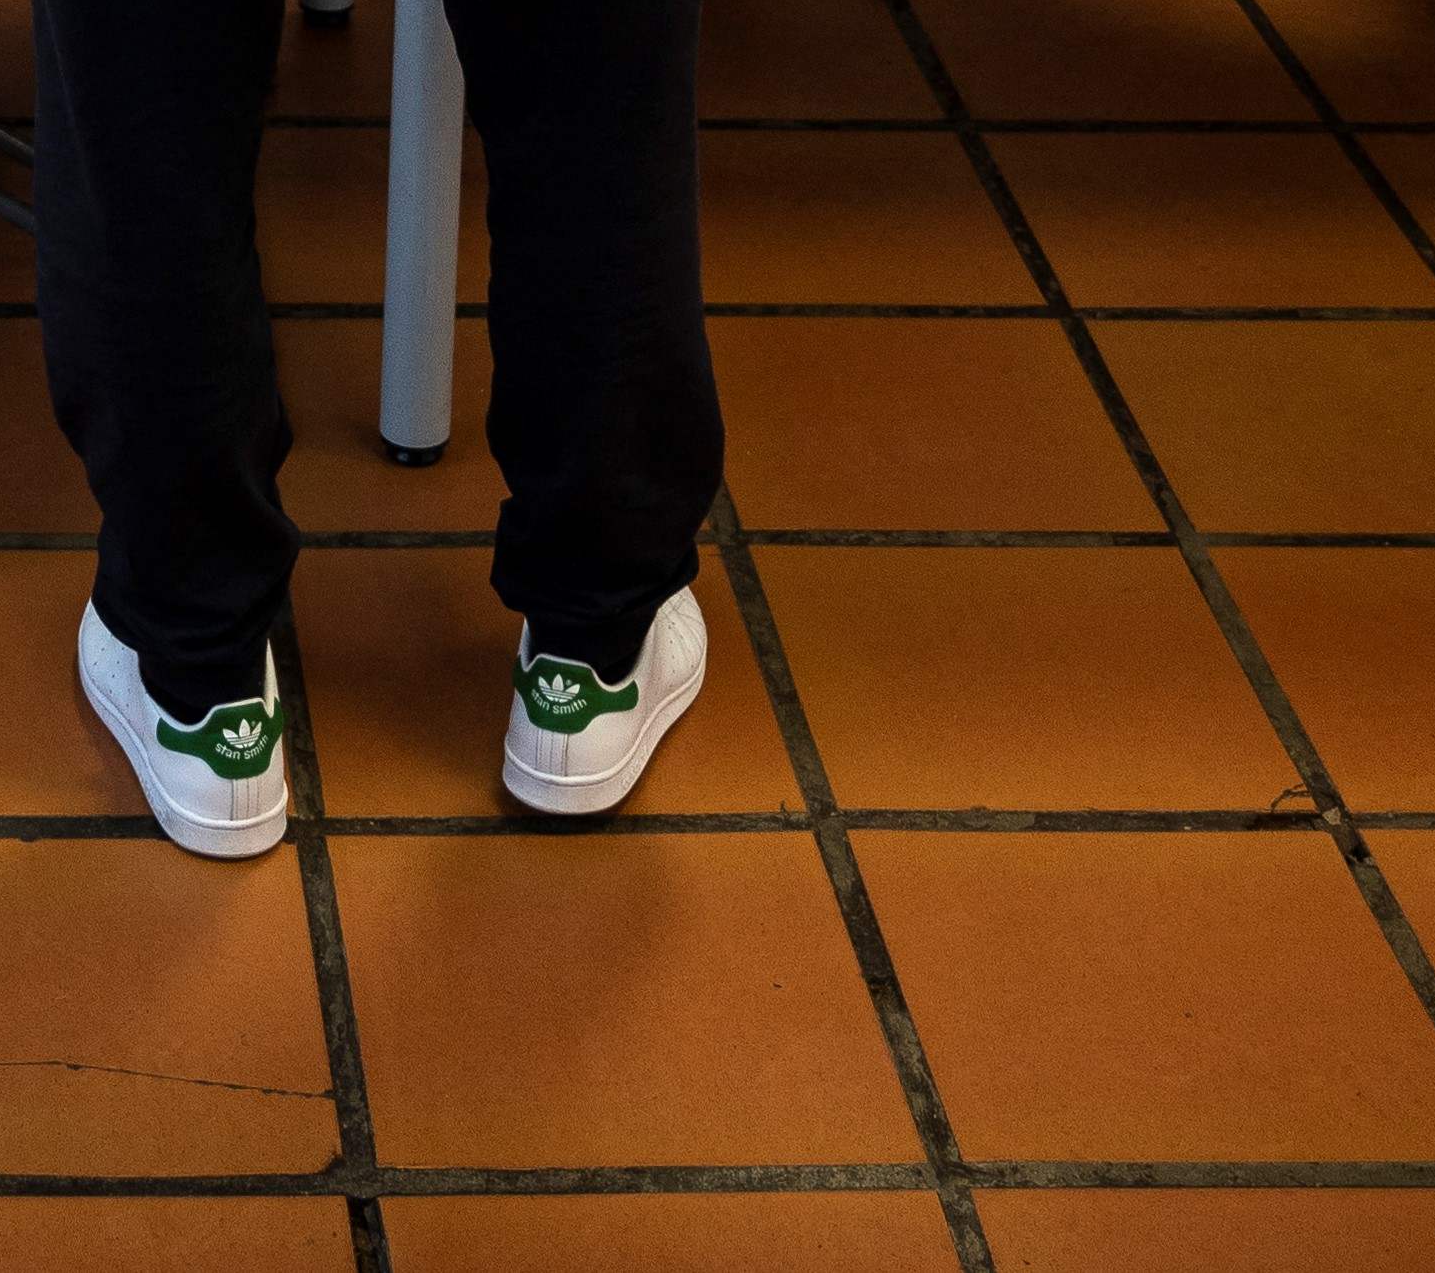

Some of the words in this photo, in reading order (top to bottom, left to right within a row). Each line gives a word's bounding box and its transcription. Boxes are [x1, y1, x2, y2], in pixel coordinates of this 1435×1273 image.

[552, 699, 587, 714] smith
[215, 743, 241, 760] stan
[243, 734, 269, 760] smith
